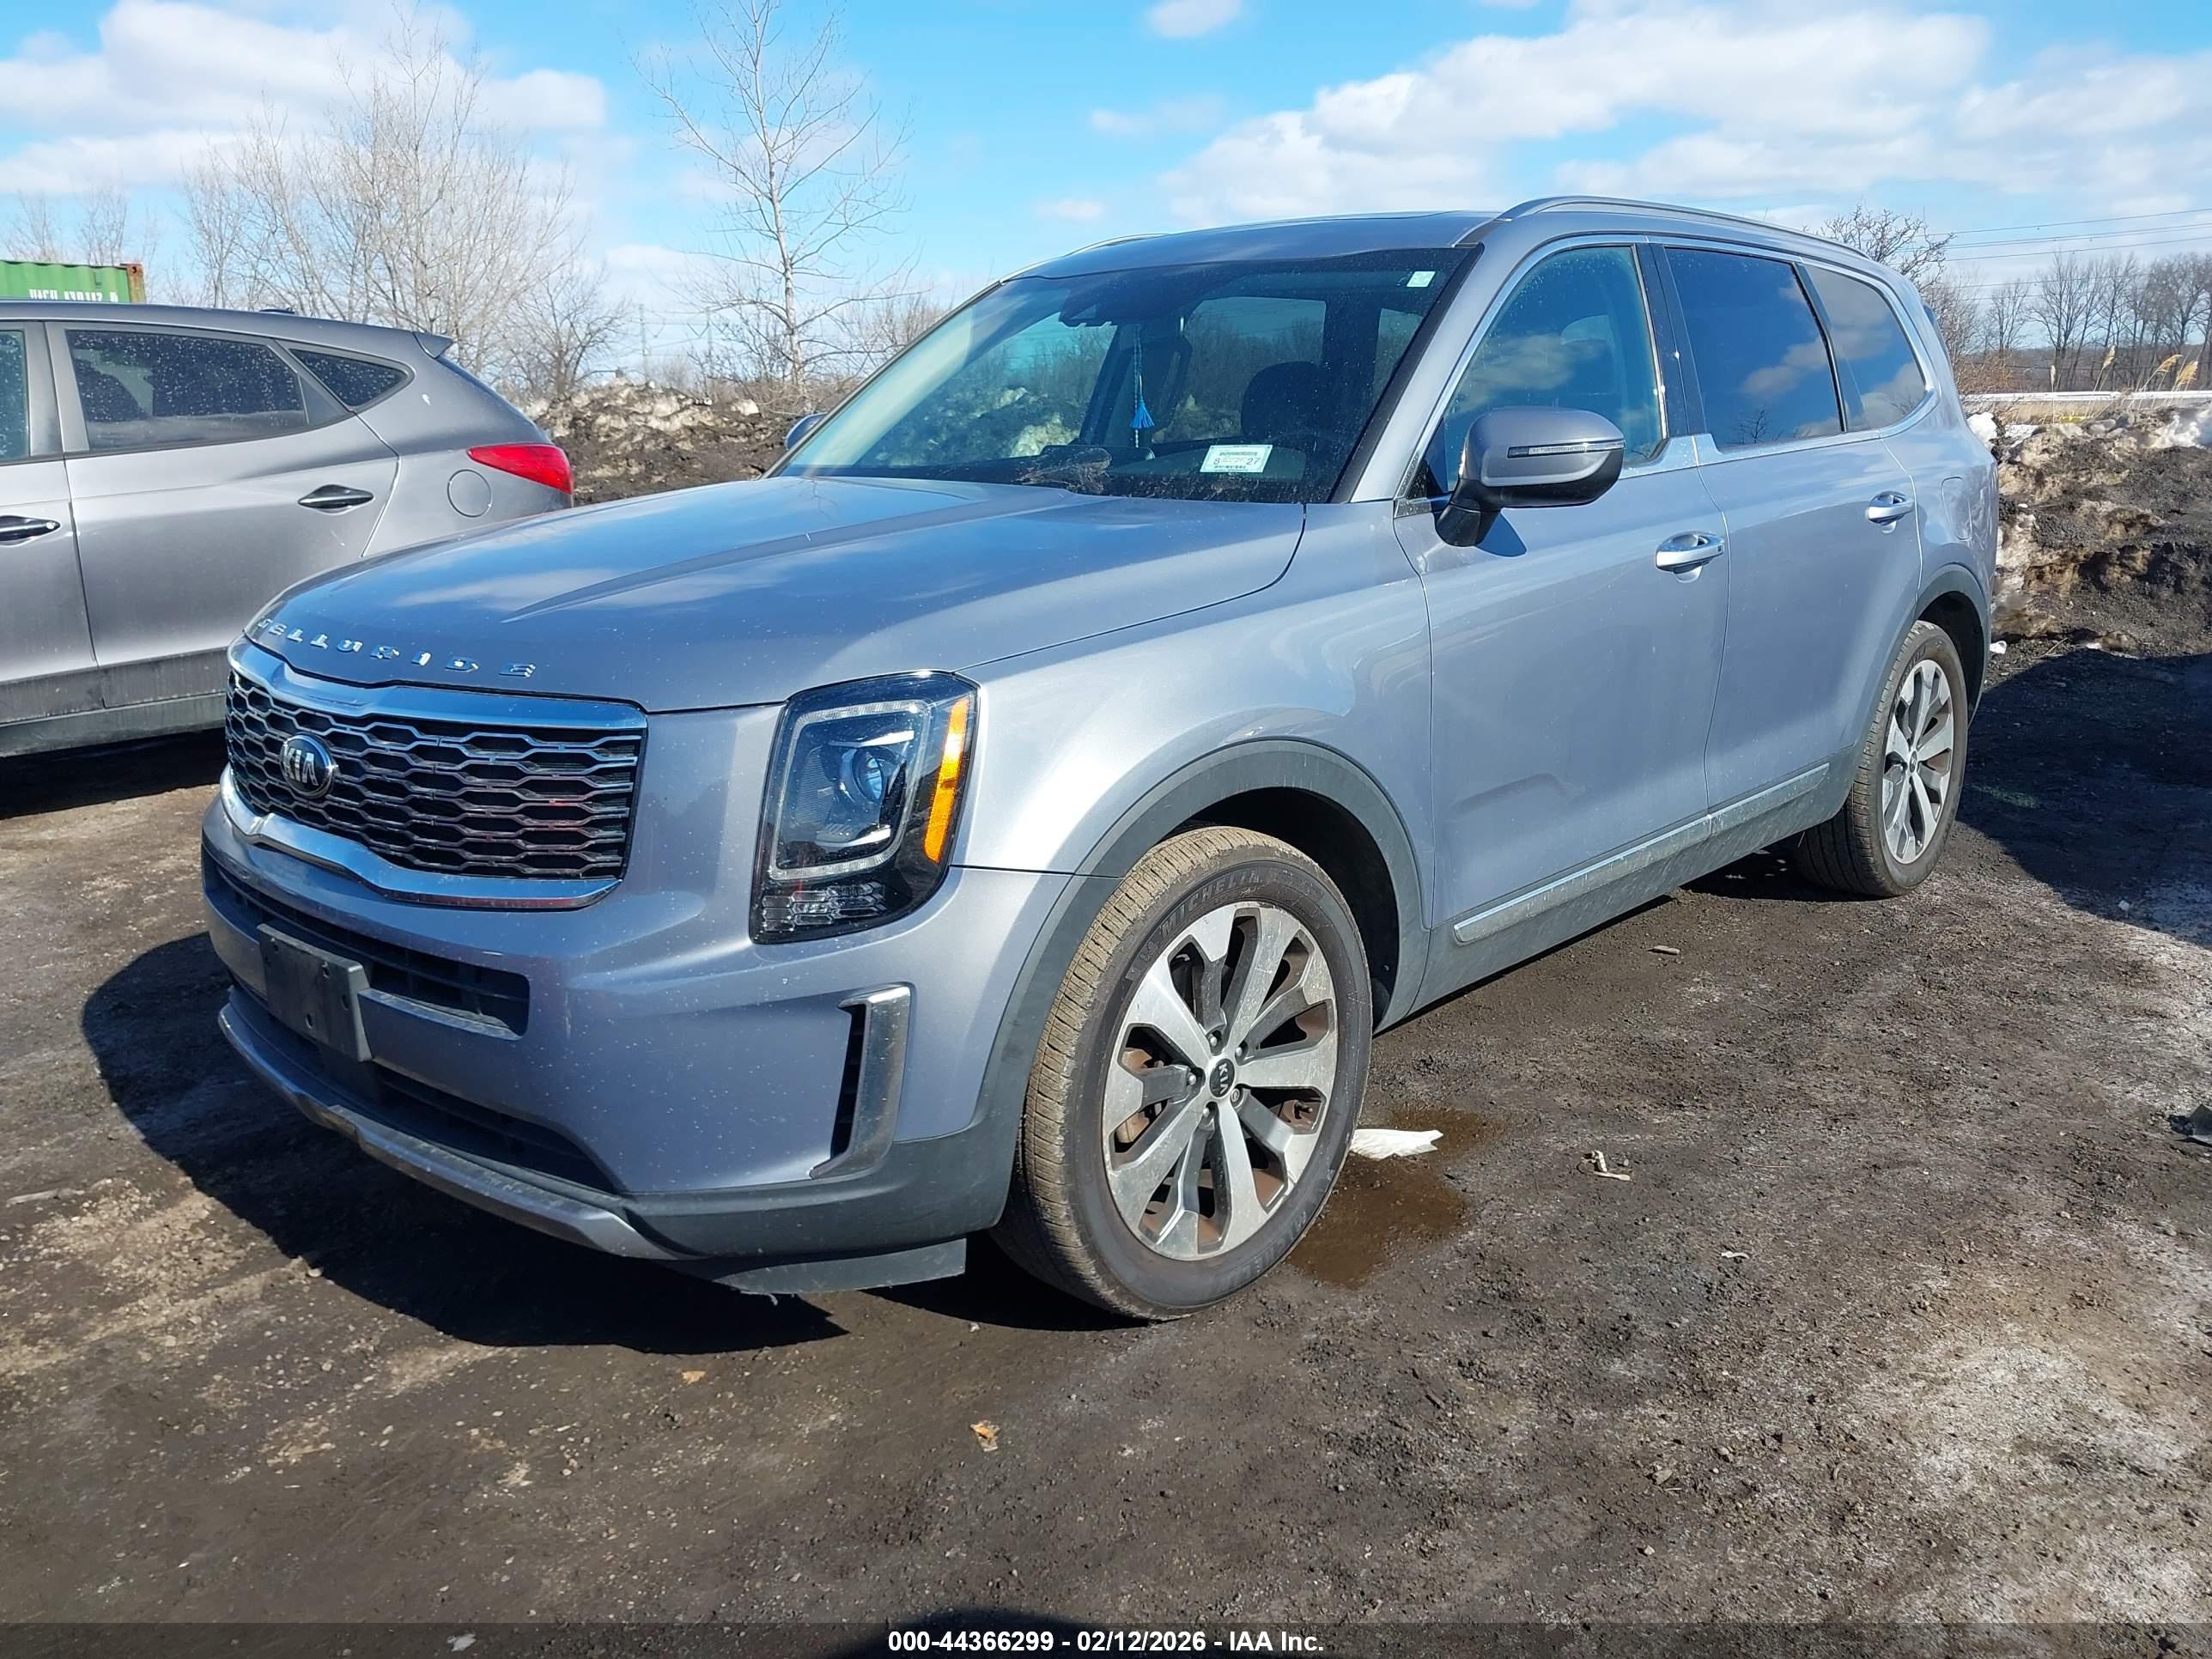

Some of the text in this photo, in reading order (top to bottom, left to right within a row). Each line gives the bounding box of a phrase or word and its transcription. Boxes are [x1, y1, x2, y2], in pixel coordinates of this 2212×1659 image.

[257, 617, 536, 679] TELLURIDE
[283, 747, 319, 786] KIA
[1161, 870, 1260, 935] MICHELIN
[1218, 1062, 1229, 1095] KIA
